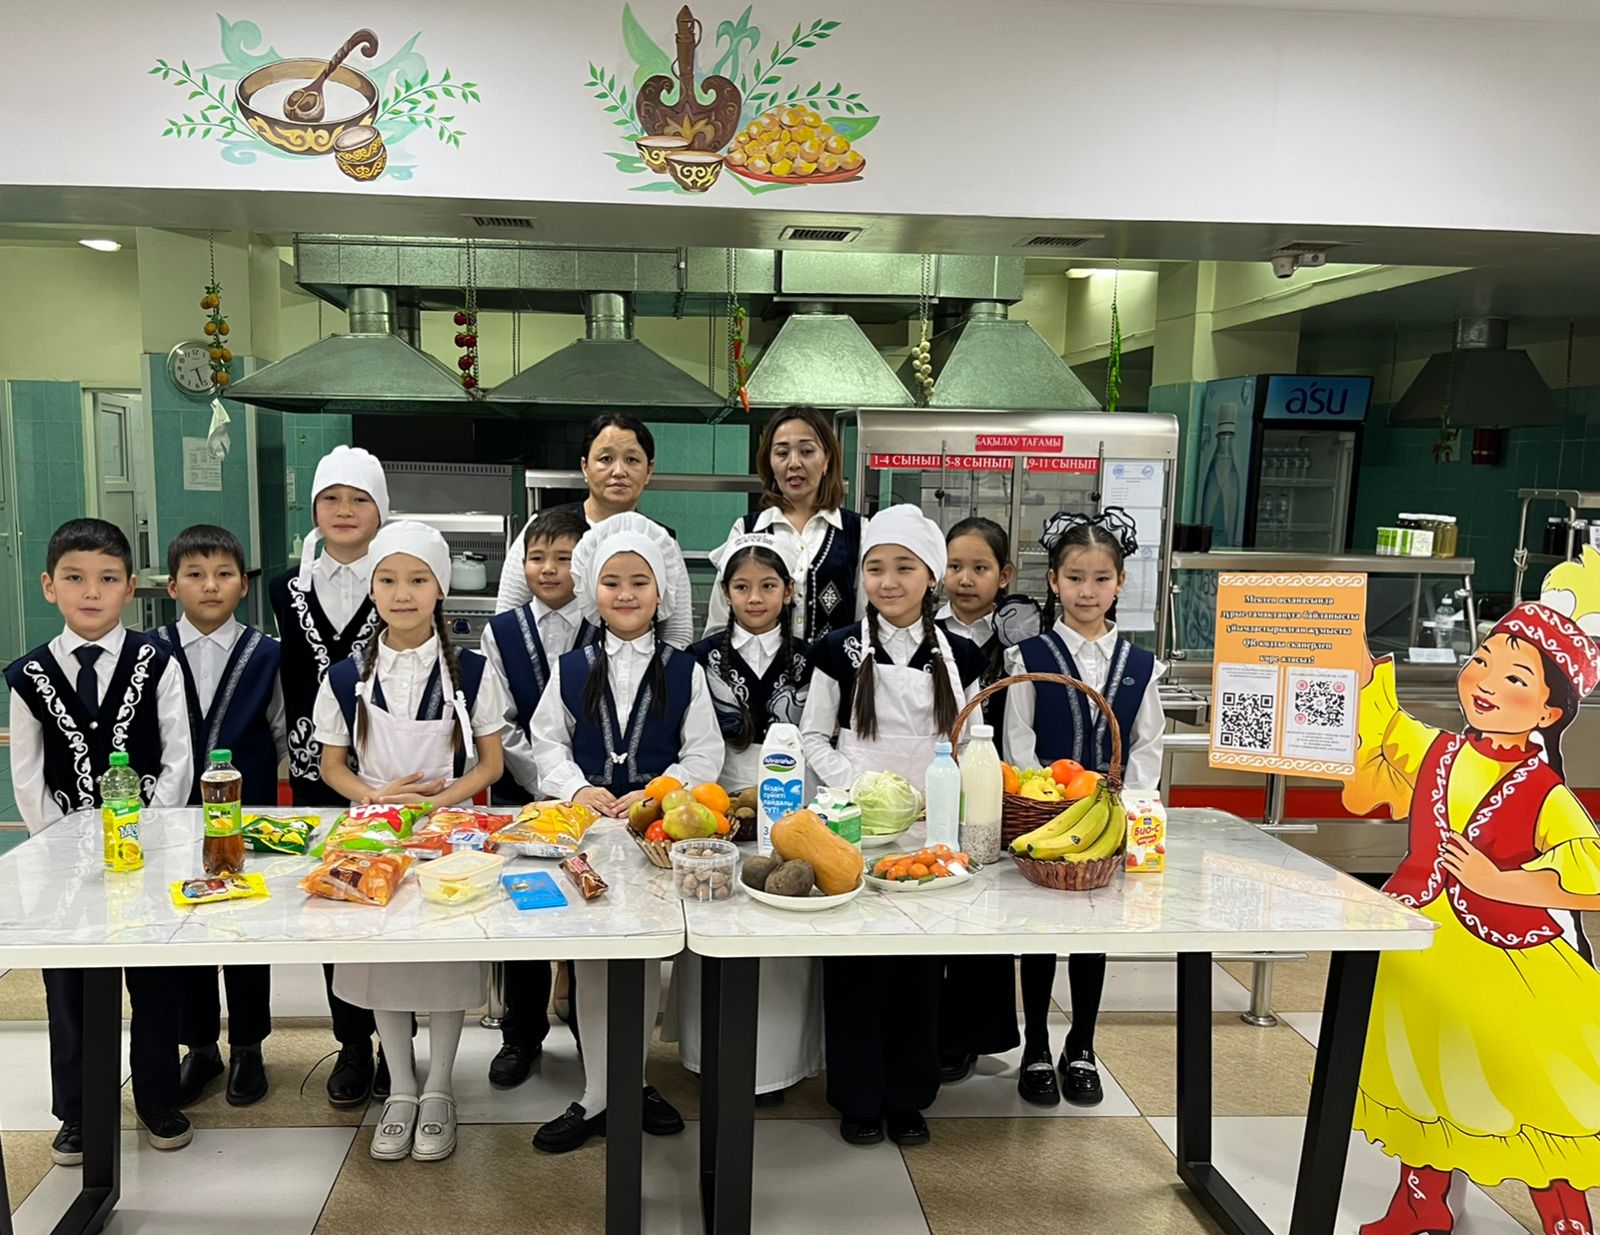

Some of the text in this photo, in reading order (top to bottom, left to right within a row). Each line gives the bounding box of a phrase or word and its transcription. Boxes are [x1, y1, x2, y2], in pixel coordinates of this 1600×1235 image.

[1022, 437, 1061, 447] ТАҒАМЫ
[874, 455, 941, 466] 1-4 СЫНЫП
[945, 456, 1012, 468] 5-8 СЫНЫП
[1051, 458, 1097, 470] СЫНЫП
